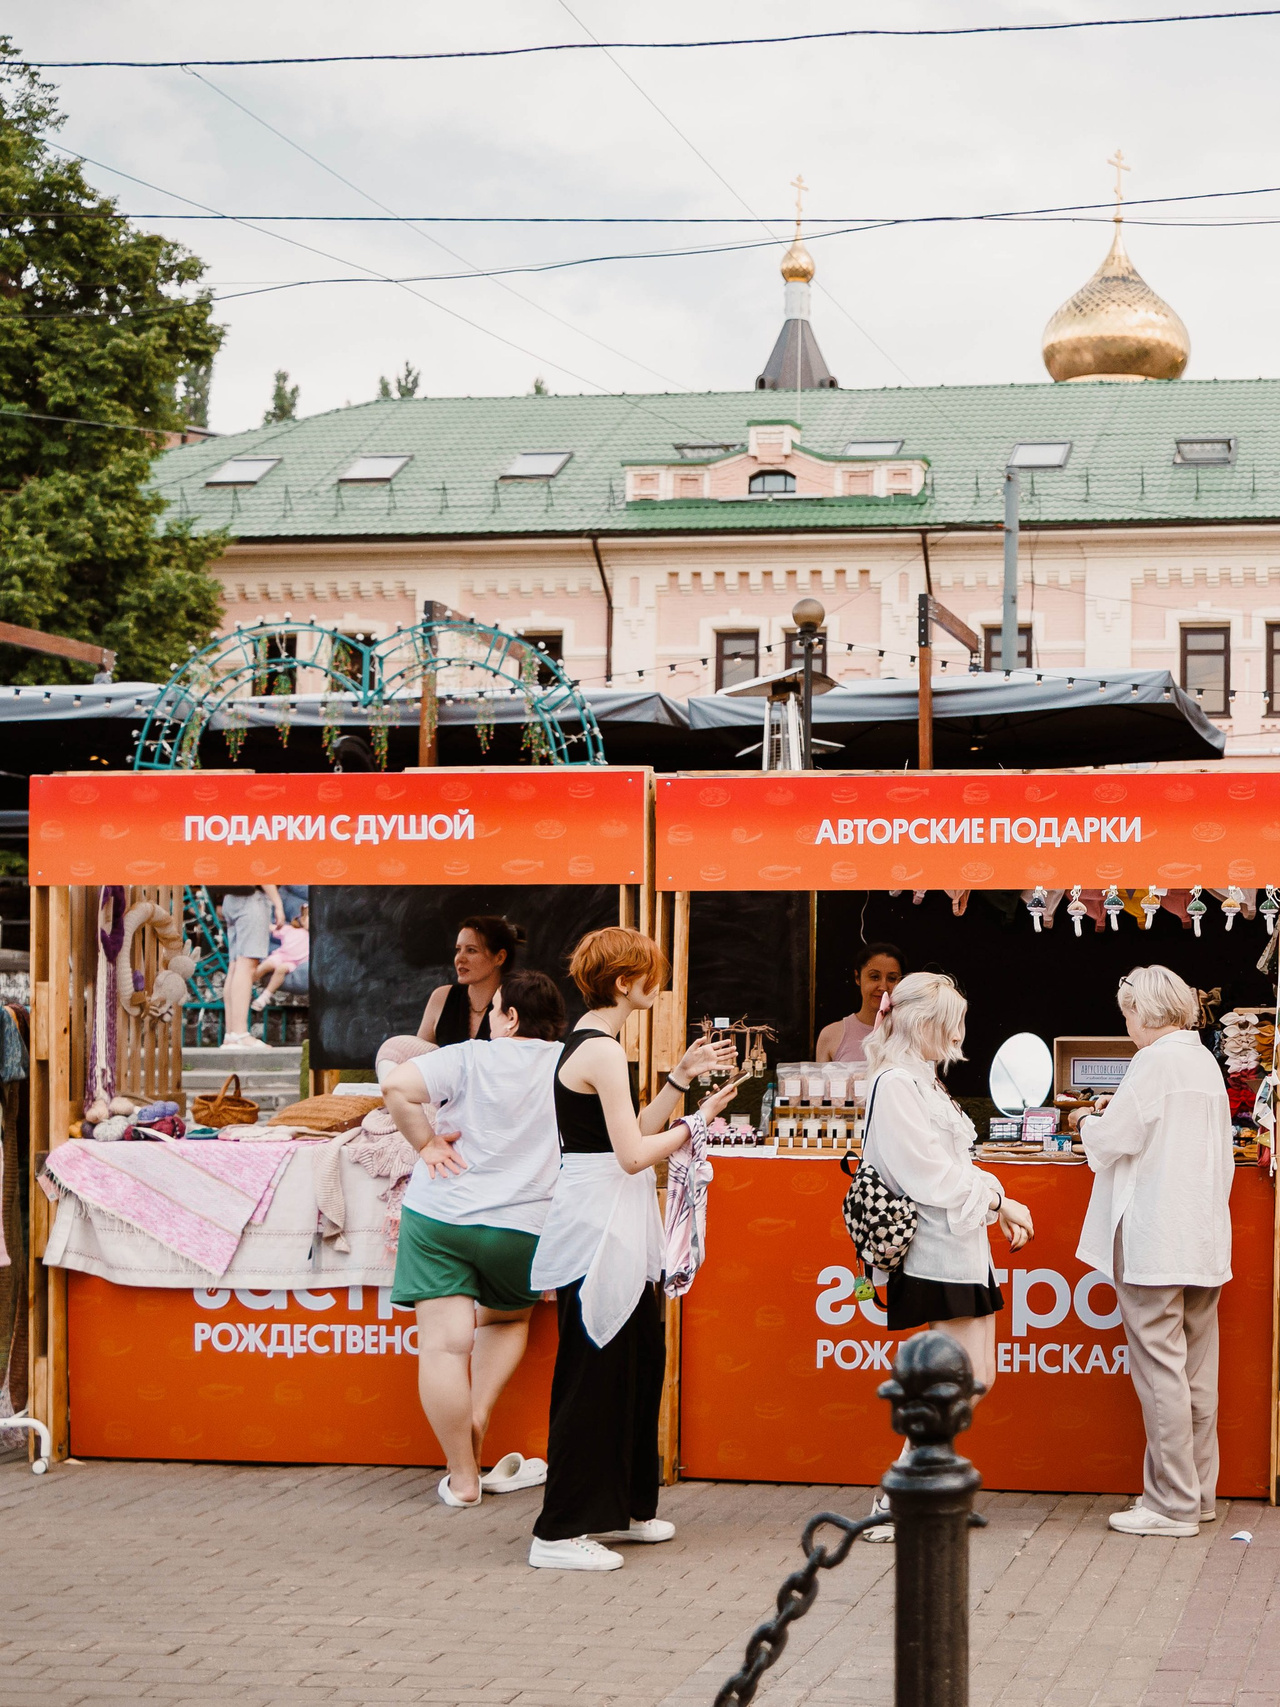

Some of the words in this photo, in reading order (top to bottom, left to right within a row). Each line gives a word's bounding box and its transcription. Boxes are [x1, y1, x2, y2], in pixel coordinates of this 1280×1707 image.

[185, 815, 326, 845] ПОДАРКИ
[330, 815, 351, 841] С
[354, 809, 475, 845] ДУШОЙ
[814, 818, 984, 845] АВТОРСКИЕ
[990, 817, 1142, 848] ПОДАРКИ
[815, 1338, 1130, 1375] РОЖЕНСКАЯ
